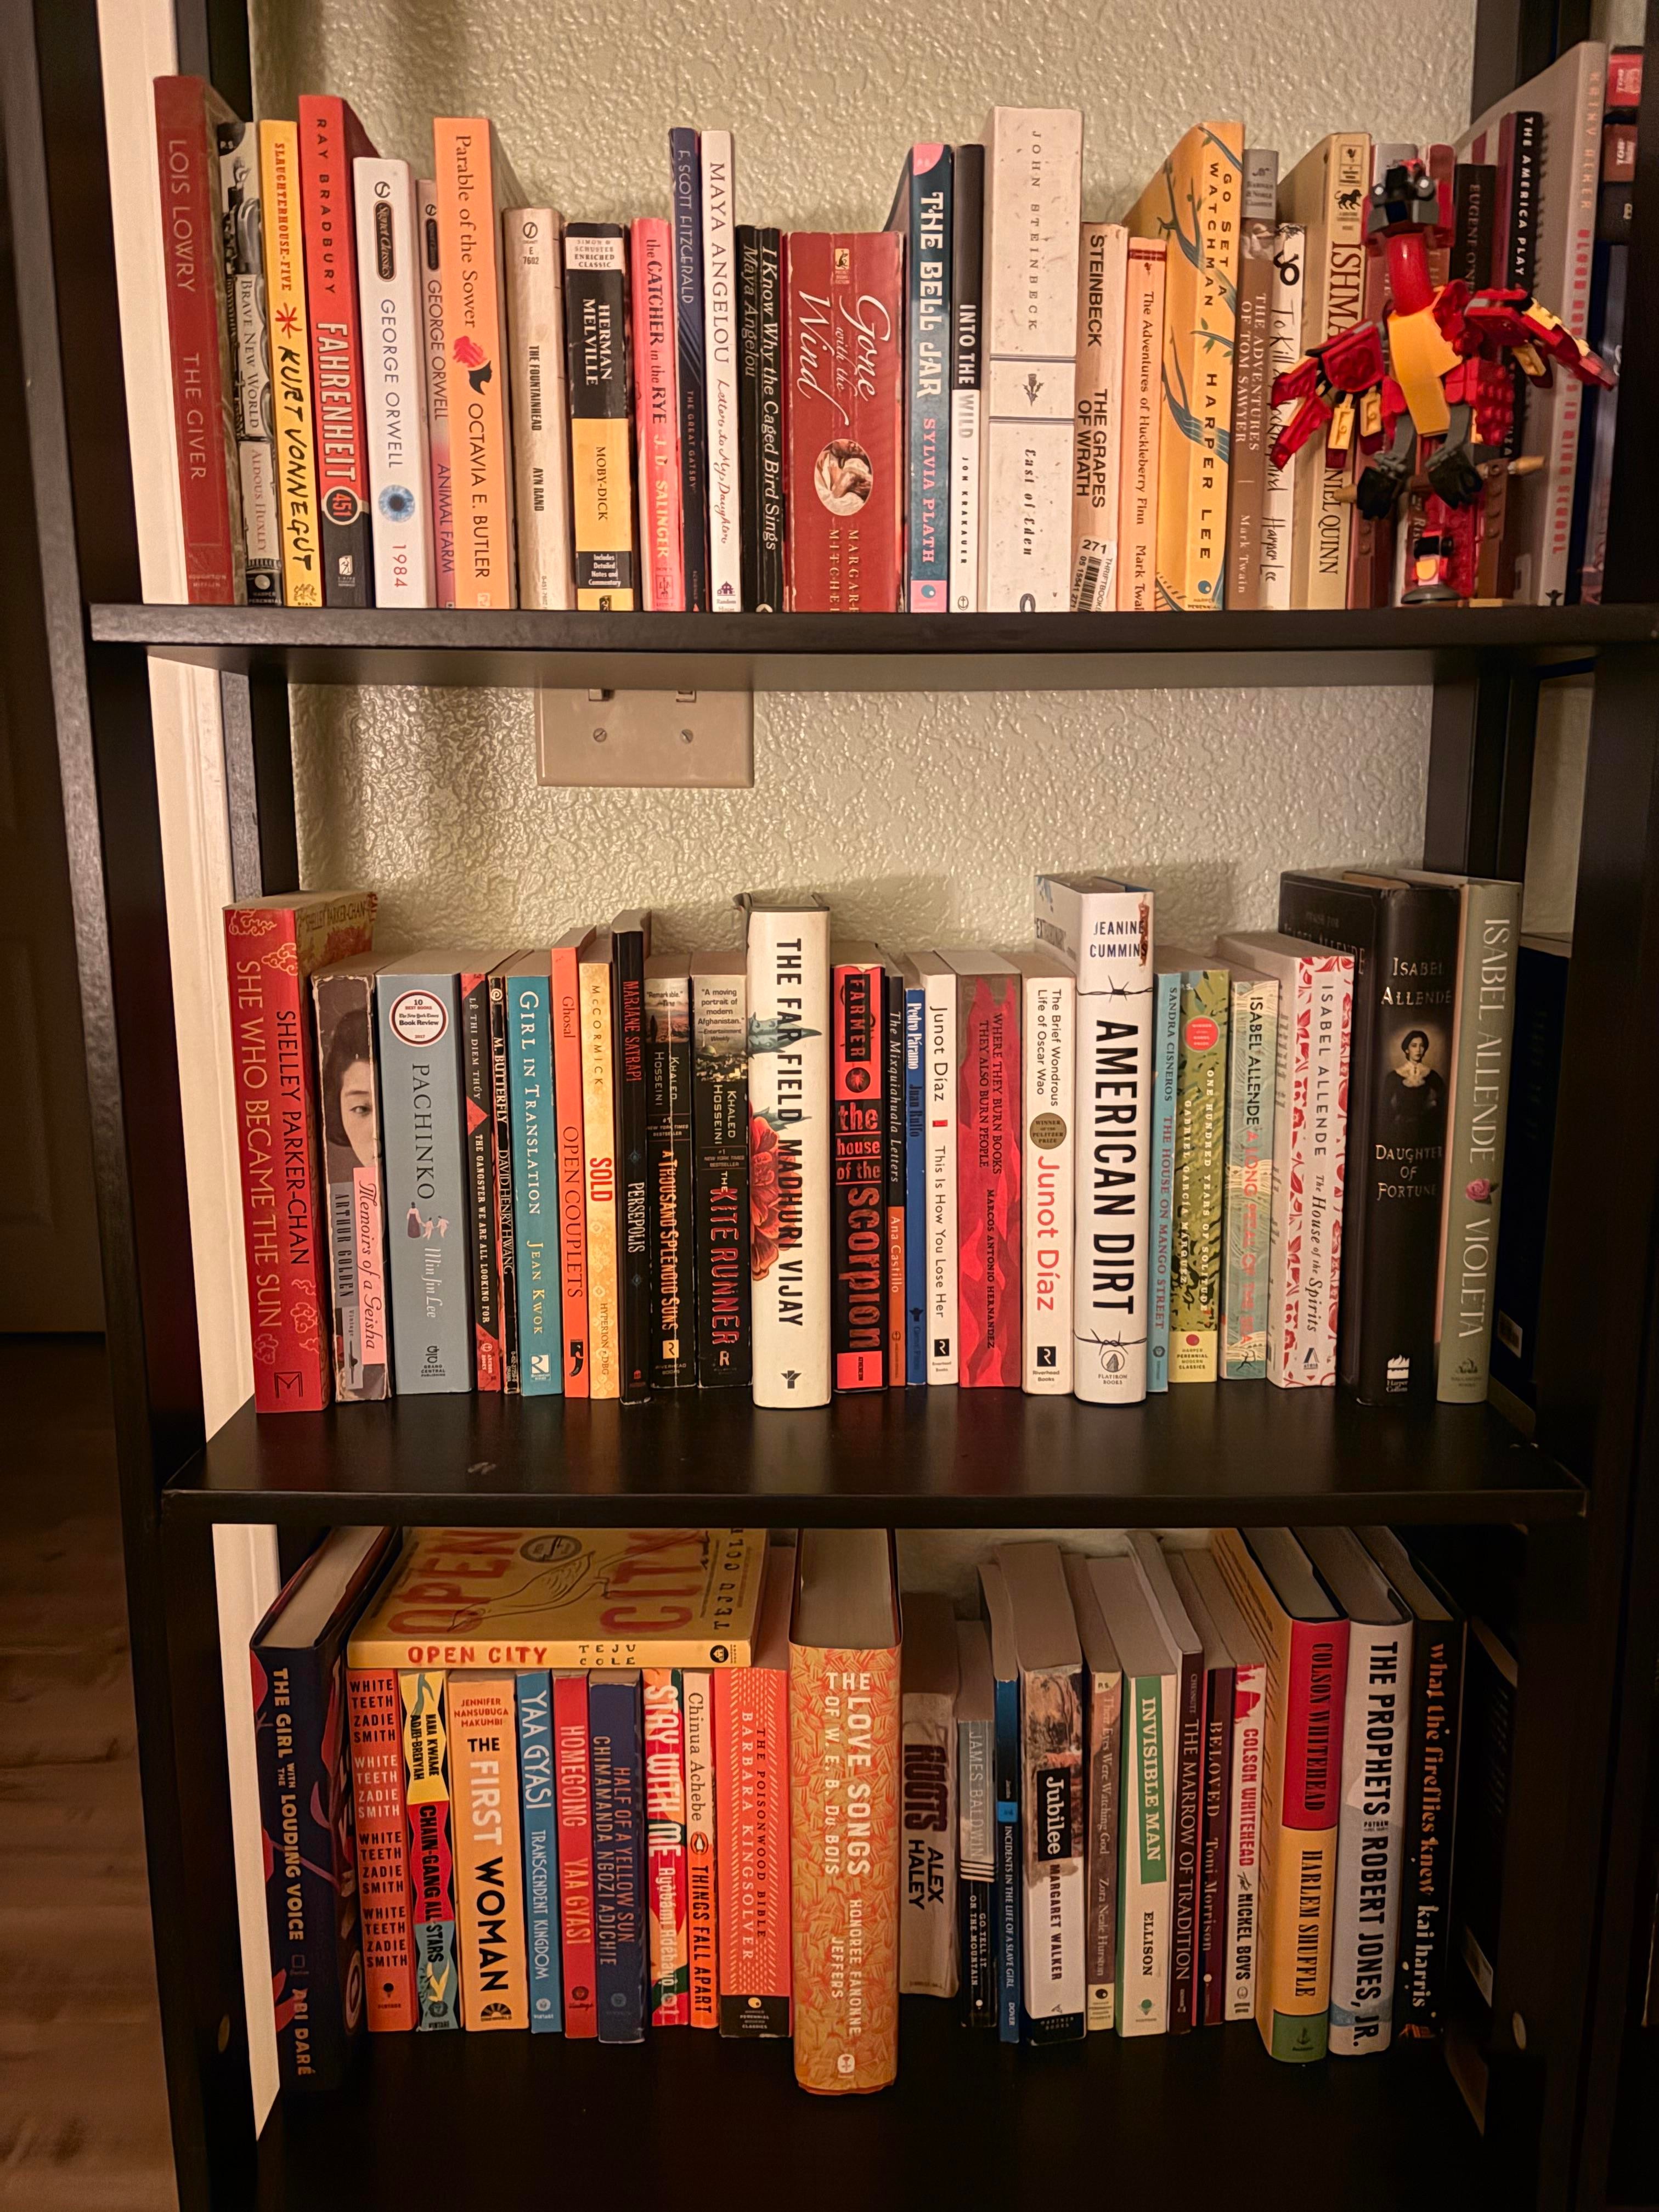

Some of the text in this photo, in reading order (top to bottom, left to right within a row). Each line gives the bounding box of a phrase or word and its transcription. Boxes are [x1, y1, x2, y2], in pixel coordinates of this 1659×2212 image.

[168, 140, 195, 292] LOIS LOWRY
[274, 142, 292, 291] SLAUGHTERHOUSE-FIVE
[316, 119, 335, 294] RAY BRADBURY
[456, 135, 478, 329] Parable of the Sower
[1028, 131, 1041, 331] JOHN STEINBECK
[1515, 116, 1534, 275] THE AMERICA PLAY
[710, 162, 729, 364] MAYA ANGELOU
[917, 191, 943, 399] THE BELL JAR
[1087, 234, 1105, 348] STEINBECK
[381, 299, 404, 469] GEORGE ORWELL
[528, 345, 542, 431] THE FOUNTAINHEAD
[583, 299, 598, 385] MELVILLE
[599, 304, 612, 380] HERMAN
[183, 353, 206, 479] THE GIVER
[278, 346, 315, 571] KURT VONNEGUT
[316, 323, 357, 482] FAHRENHEIT
[1076, 400, 1091, 496] OF WRATH
[1092, 388, 1107, 509] THE GRAPES
[332, 494, 352, 516] 451
[468, 403, 490, 578] OCTAVIA E. BUTLER
[532, 467, 544, 511] AYN RAND
[596, 447, 608, 520] MOBY-DICK
[922, 418, 935, 563] SYLVIA PLATH
[1200, 374, 1217, 558] HARPER LEE
[392, 544, 408, 588] 1984
[1083, 540, 1107, 553] 271
[1090, 944, 1148, 957] CUMMINS
[1093, 921, 1144, 935] JEANINE
[562, 996, 575, 1038] Ghosal
[701, 998, 729, 1006] portrait
[777, 938, 802, 1121] THE FAR FIELD
[850, 980, 865, 1057] FARMER
[1470, 919, 1510, 1164] ISABEL ALLENDE
[523, 1058, 535, 1077] IN
[714, 1085, 723, 1144] HOSSEINI
[727, 1091, 736, 1138] KHALED
[236, 961, 282, 1327] SHE WHO BECAME THE SUN
[276, 1011, 309, 1265] SHELLEY PARKER-CHAN
[412, 1064, 435, 1200] PACHINKO
[590, 1158, 612, 1202] SOLD
[1093, 1019, 1138, 1314] AMERICAN DIRT
[1401, 1165, 1417, 1178] OF
[335, 1194, 354, 1297] ARTHUR GOLDEN
[563, 1126, 582, 1299] OPEN COUPLETS
[628, 1182, 645, 1253] PERSEPOLIS
[778, 1139, 803, 1326] MADHURI VIJAY
[1038, 1156, 1060, 1311] Junot Díaz
[1459, 1218, 1491, 1339] VIOLETA
[350, 1679, 393, 1692] WHITE
[352, 1695, 393, 1709] TEETH
[408, 1646, 548, 1664] OPEN CITY
[461, 1699, 501, 1707] JENNIFER
[579, 1645, 636, 1654] TEJU
[580, 1657, 636, 1666] COLE
[354, 1713, 394, 1726] ZADIE
[354, 1730, 396, 1742] SMITH
[454, 1708, 509, 1718] NANSUBUGA
[461, 1718, 503, 1727] MAKUMBI
[521, 1690, 551, 1809] YAA GYASI
[688, 1692, 708, 1821] Chinua Achebe
[1363, 1641, 1398, 1816] THE PROPHETS
[273, 1667, 303, 1941] THE GIRL WITH THE LOUDING VOICE
[560, 1725, 586, 1827] HOMEGOING
[1046, 1776, 1065, 1856] Jubilee
[1142, 1699, 1161, 1861] INVISIBLE MAN
[1239, 1728, 1259, 1867] COLSON WHITEHEAD
[467, 1737, 509, 1992] THE FIRST WOMAN
[742, 1712, 754, 1960] BARBARA KINGSOLVER
[757, 1729, 766, 1938] THE POISONWOOD BIBLE
[908, 1839, 925, 1910] HALEY
[927, 1846, 944, 1904] ALEX
[532, 1830, 550, 1980] TRANSCENDENT KINGDOM
[692, 1866, 712, 2014] THINGS FALL APART
[1049, 1865, 1062, 1980] MARGARET WALKER
[1142, 1911, 1153, 1976] ELLISON
[1235, 1894, 1253, 1980] NICKEL BOYS
